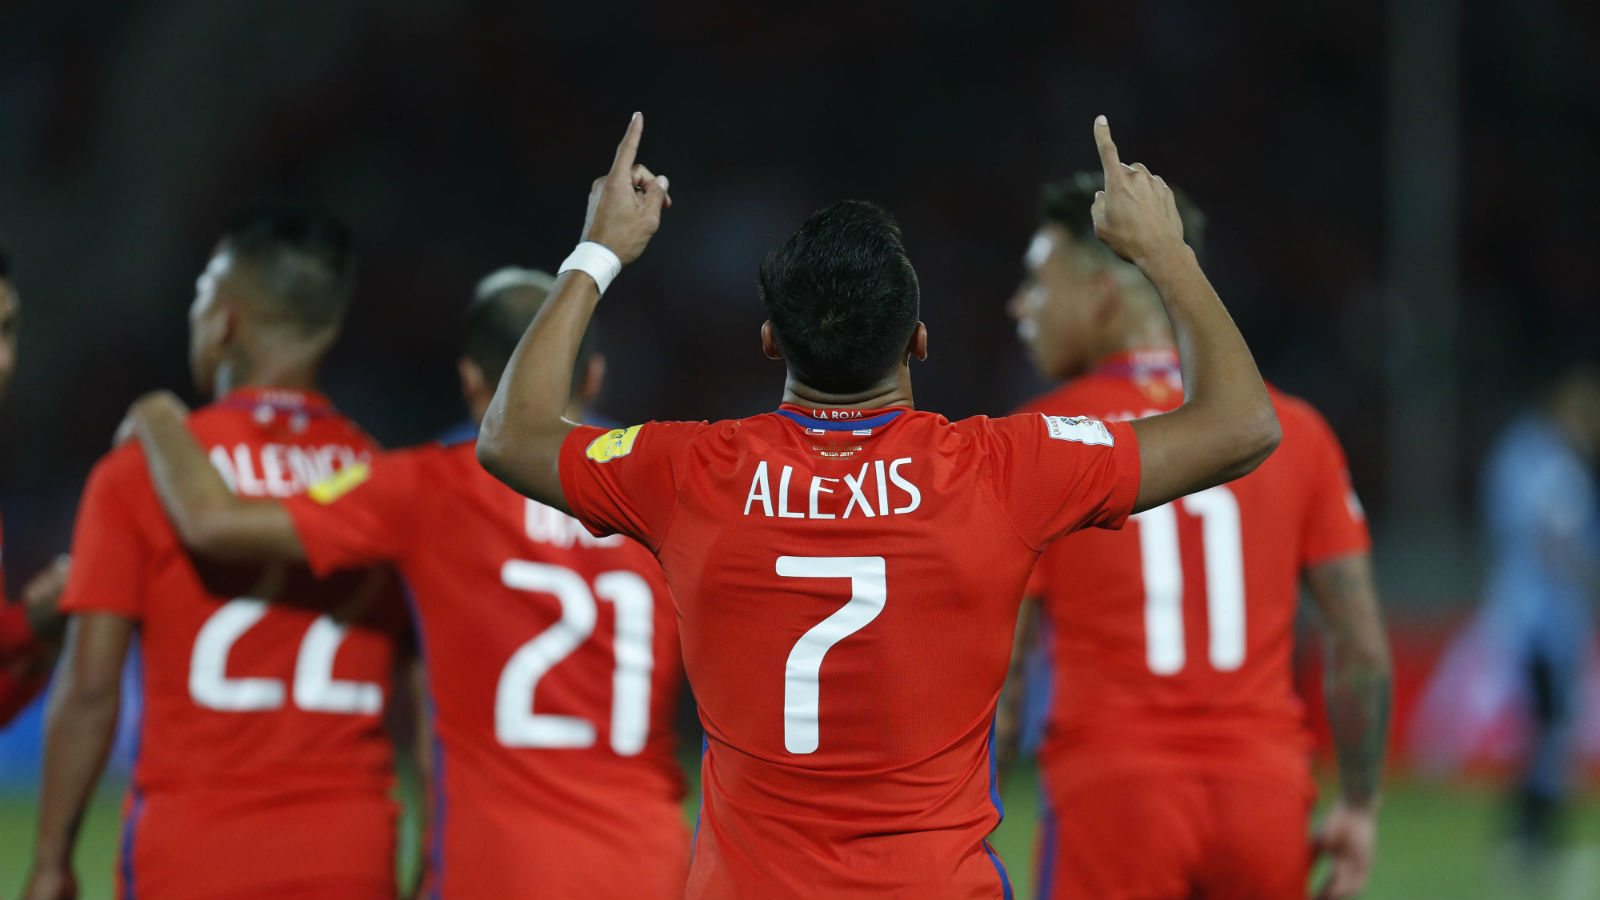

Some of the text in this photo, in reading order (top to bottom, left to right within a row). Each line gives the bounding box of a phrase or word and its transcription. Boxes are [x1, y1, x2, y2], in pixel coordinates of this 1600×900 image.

[743, 457, 921, 519] ALEXIS
[813, 409, 863, 419] LA ROJA
[188, 580, 384, 715] 22
[494, 558, 653, 756] 21
[775, 555, 887, 754] 7
[1128, 485, 1246, 676] 11
